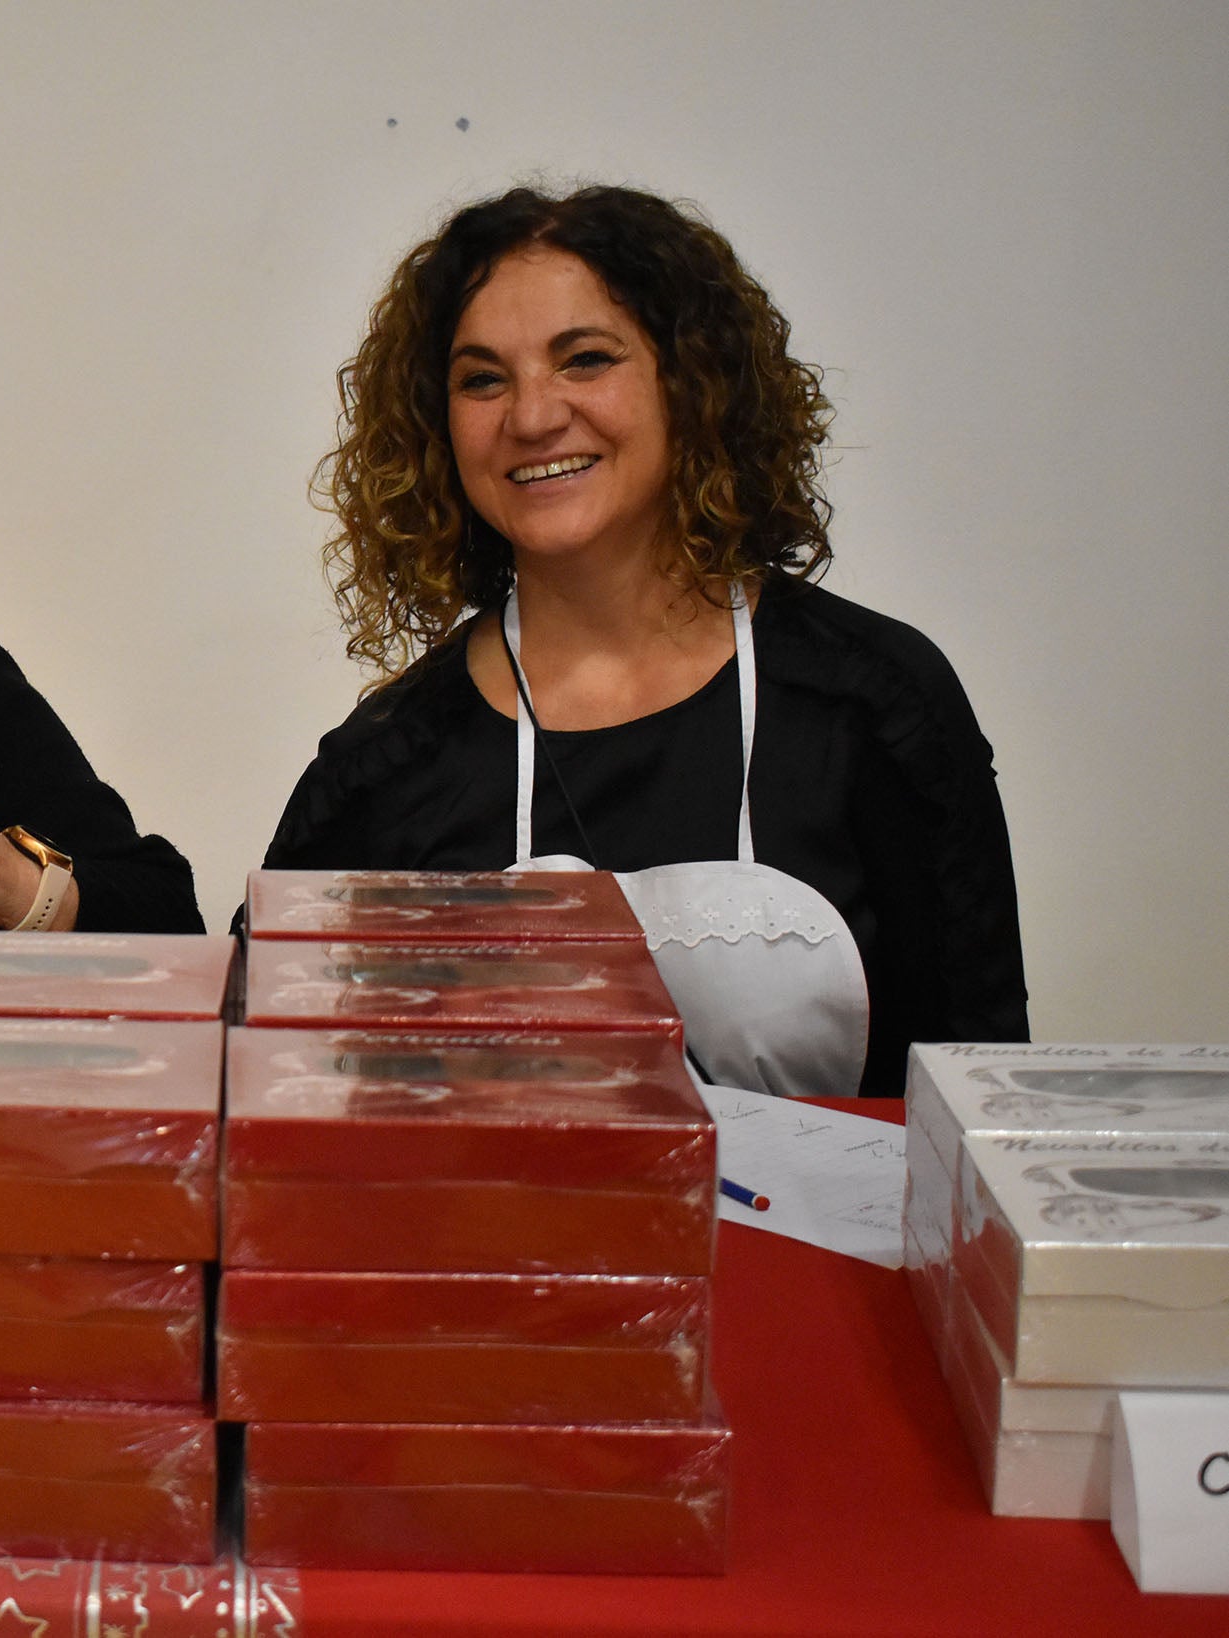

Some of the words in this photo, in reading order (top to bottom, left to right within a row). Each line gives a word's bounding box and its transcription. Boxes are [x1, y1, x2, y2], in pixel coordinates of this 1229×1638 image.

[940, 1044, 1109, 1058] Nevaditos
[1126, 1046, 1164, 1058] de
[993, 1137, 1177, 1152] Nevaditos
